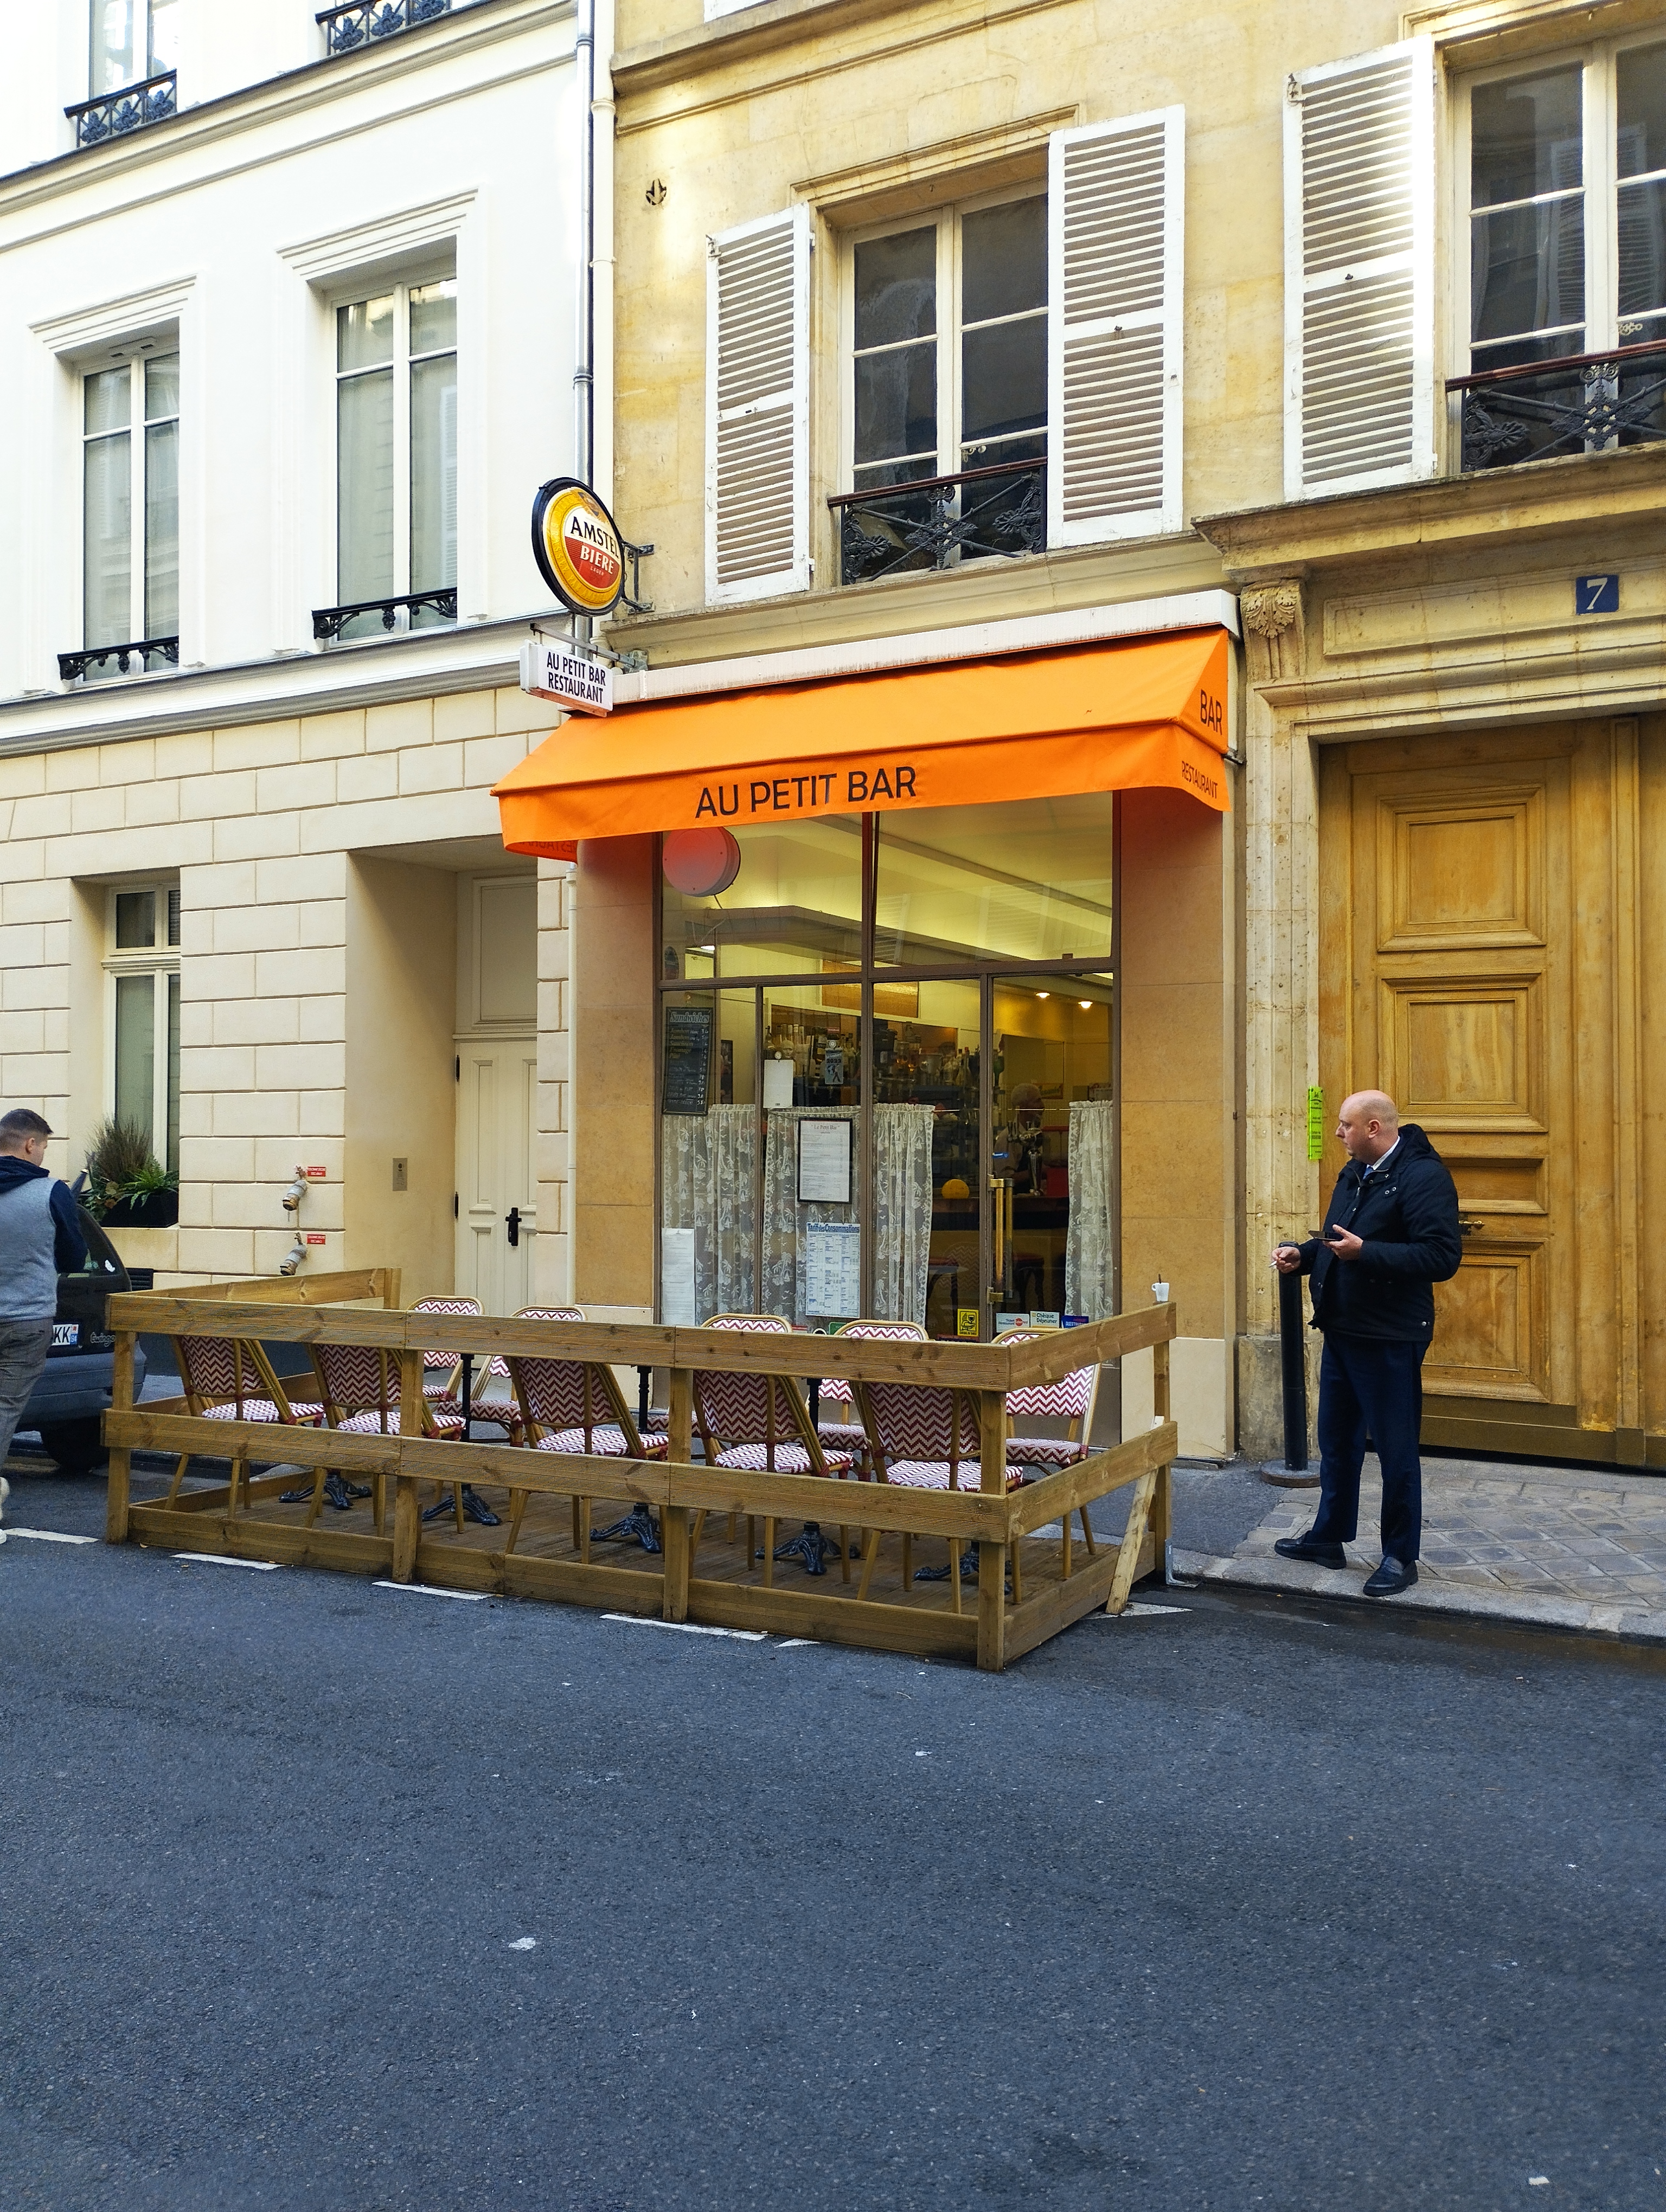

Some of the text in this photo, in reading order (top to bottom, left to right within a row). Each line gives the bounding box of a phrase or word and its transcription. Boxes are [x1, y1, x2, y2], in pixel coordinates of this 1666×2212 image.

[570, 516, 619, 559] AMSTEL
[580, 545, 614, 575] BIERE
[1586, 577, 1608, 610] 7
[547, 651, 606, 686] AU PETIT BAR
[548, 672, 604, 704] RESTAURANT
[1200, 689, 1222, 736] BAR
[695, 766, 916, 819] AU PETIT BAR
[1181, 760, 1218, 799] RESTAURANT
[669, 1011, 710, 1024] Sandwiches
[54, 1326, 71, 1343] KK
